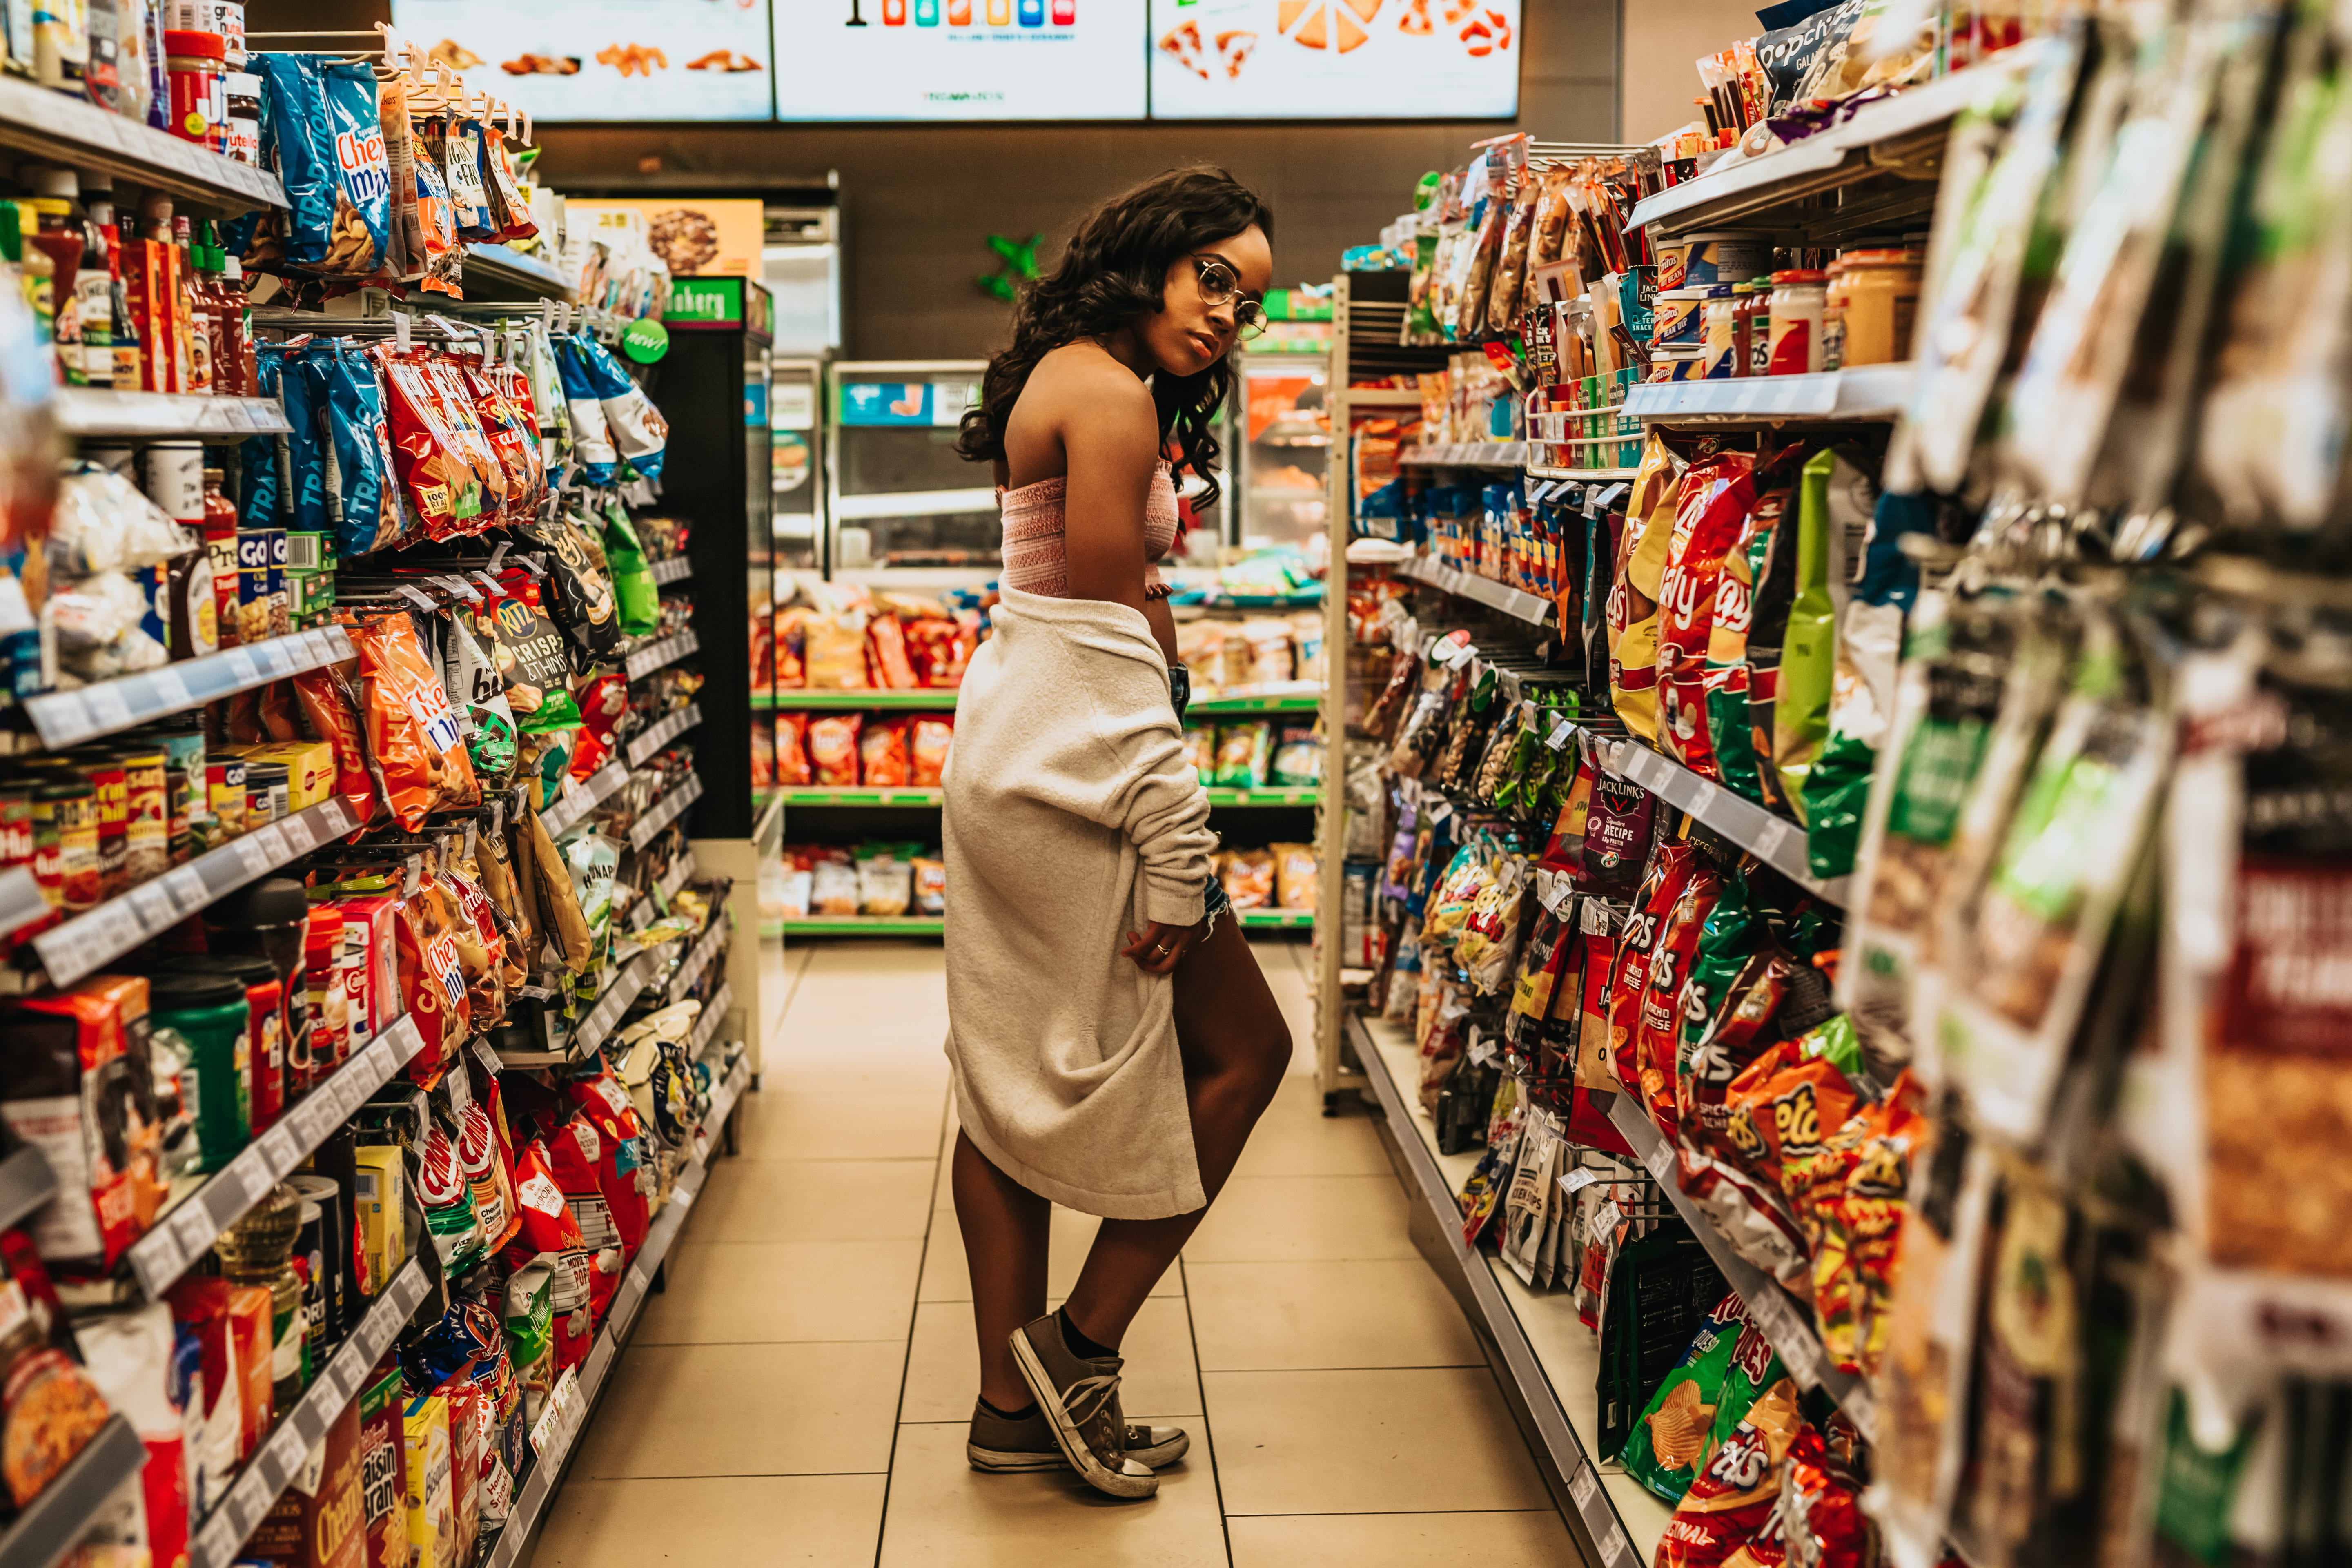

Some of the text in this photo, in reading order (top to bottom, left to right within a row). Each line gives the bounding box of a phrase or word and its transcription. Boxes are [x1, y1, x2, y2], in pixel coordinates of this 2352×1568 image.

[229, 134, 257, 149] utella
[1660, 256, 1677, 274] Fritos
[1662, 307, 1678, 325] Fritos
[1677, 317, 1688, 329] DIP
[1654, 368, 1671, 382] Fritos
[428, 492, 448, 502] 100%
[431, 499, 447, 510] REAL
[207, 544, 238, 569] Pre
[240, 541, 268, 566] GO
[497, 601, 535, 637] RITZ
[511, 634, 557, 663] CRISP
[1597, 778, 1645, 800] JACK LINK'S
[1604, 825, 1634, 842] RECIPE
[1609, 838, 1624, 846] PROTEIN
[1626, 963, 1643, 978] NACHO
[1623, 973, 1641, 990] CHEESE
[363, 1445, 395, 1486] aisin
[486, 1466, 504, 1495] Honey
